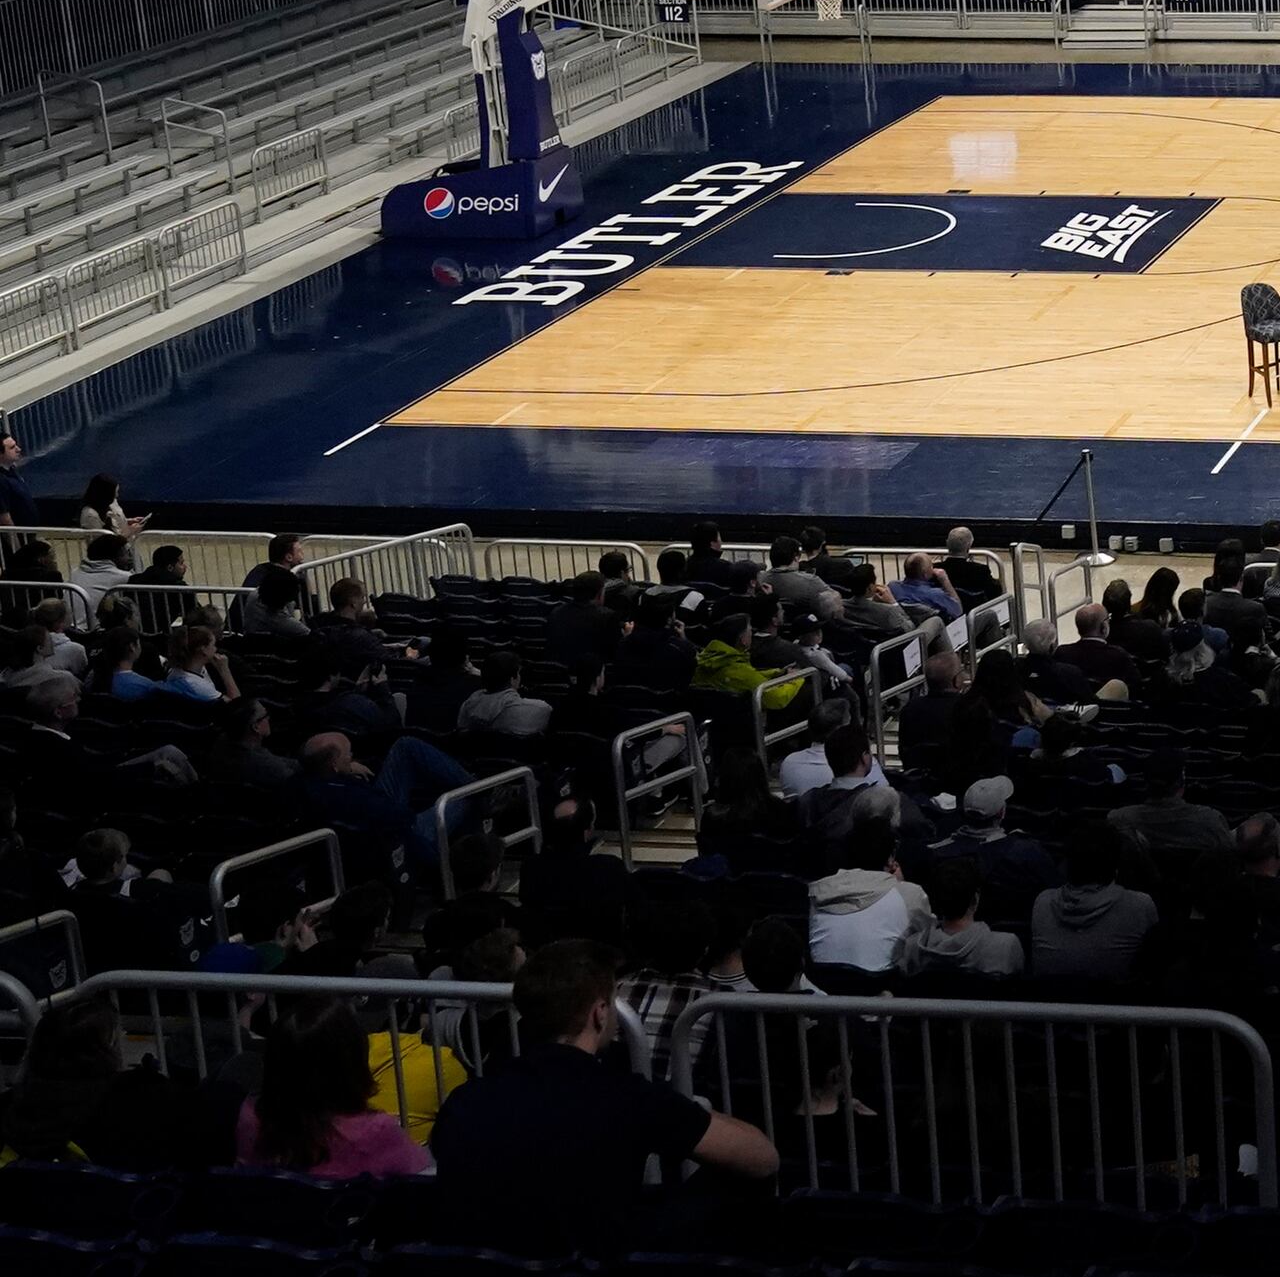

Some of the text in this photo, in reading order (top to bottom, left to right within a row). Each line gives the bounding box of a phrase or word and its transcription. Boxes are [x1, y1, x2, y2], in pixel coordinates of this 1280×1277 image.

[665, 5, 683, 21] 112
[457, 193, 519, 215] pepsi
[451, 161, 805, 305] BUTLER
[1040, 212, 1111, 253] BIG
[1074, 204, 1156, 259] EAST
